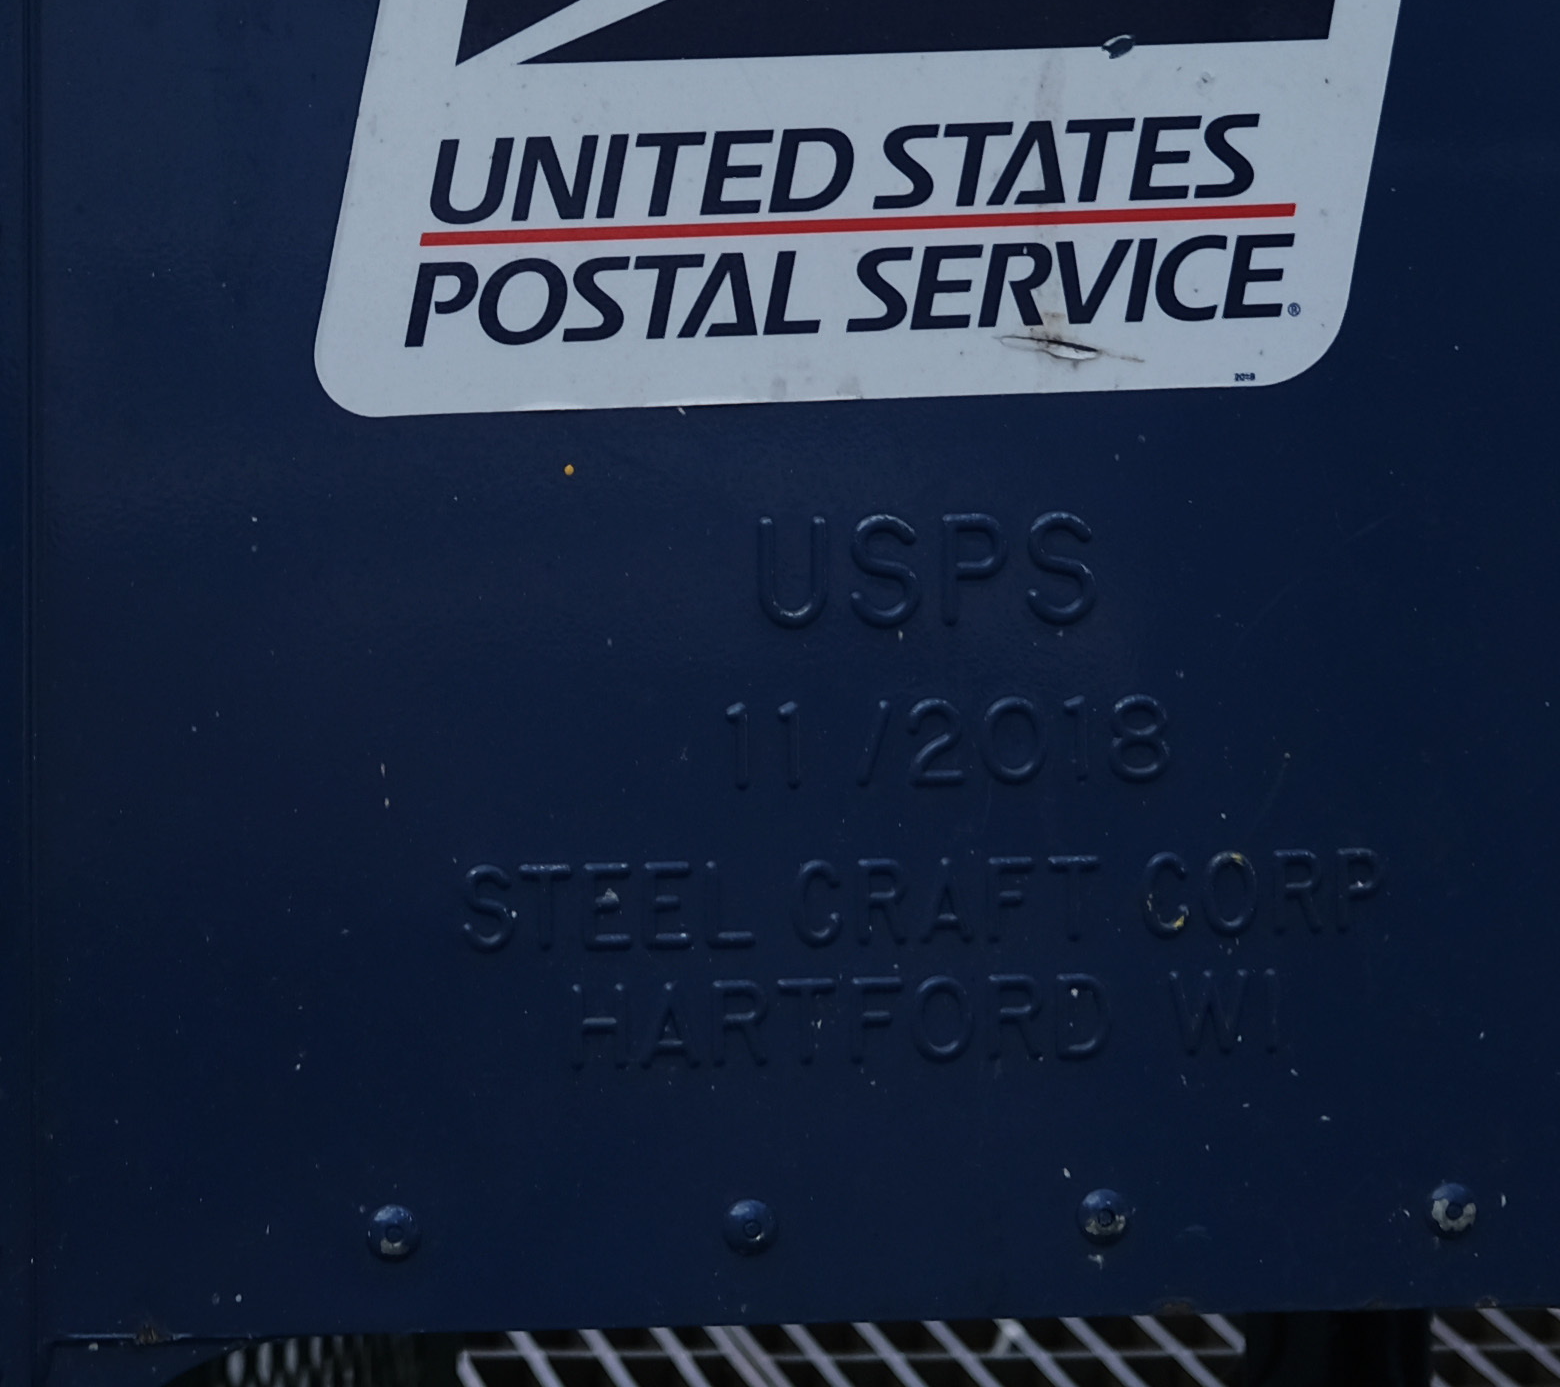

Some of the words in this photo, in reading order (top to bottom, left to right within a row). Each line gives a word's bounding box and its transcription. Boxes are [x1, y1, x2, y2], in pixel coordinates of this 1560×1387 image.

[428, 128, 854, 224] UNITED
[872, 113, 1260, 210] STATES
[404, 250, 822, 348] POSTAL
[754, 510, 1098, 628] USPS
[462, 859, 757, 953] STEEL
[791, 854, 1101, 948] CRAFT
[1140, 846, 1381, 939] CORP
[570, 972, 1110, 1070] HARTFORD
[1169, 966, 1281, 1057] WI
